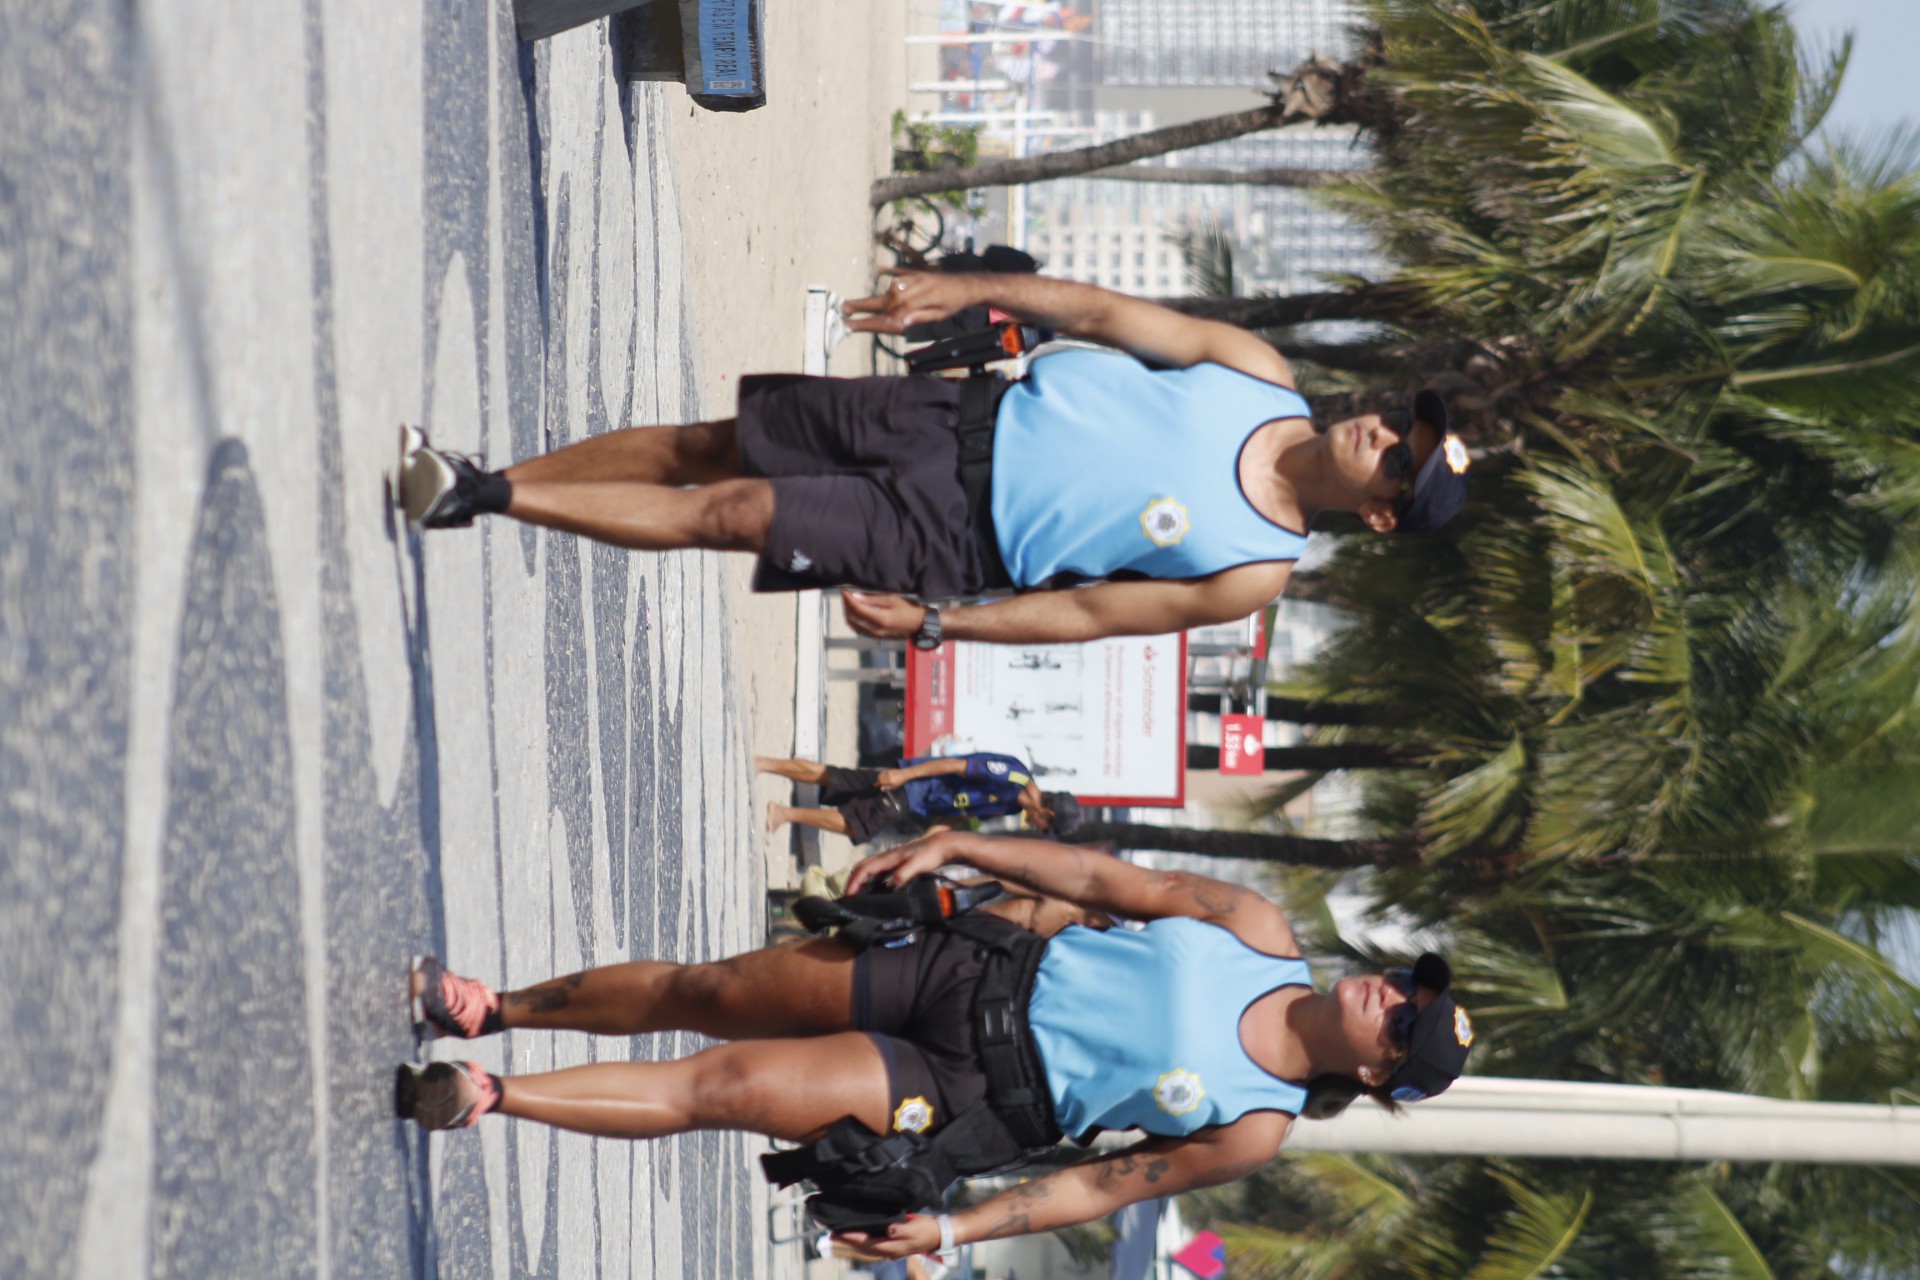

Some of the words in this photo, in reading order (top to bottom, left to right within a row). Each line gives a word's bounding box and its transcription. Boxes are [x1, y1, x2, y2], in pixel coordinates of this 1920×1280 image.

[712, 20, 735, 29] EM
[713, 32, 737, 57] TEMPO
[714, 60, 737, 78] REAL
[1142, 664, 1157, 737] Santander
